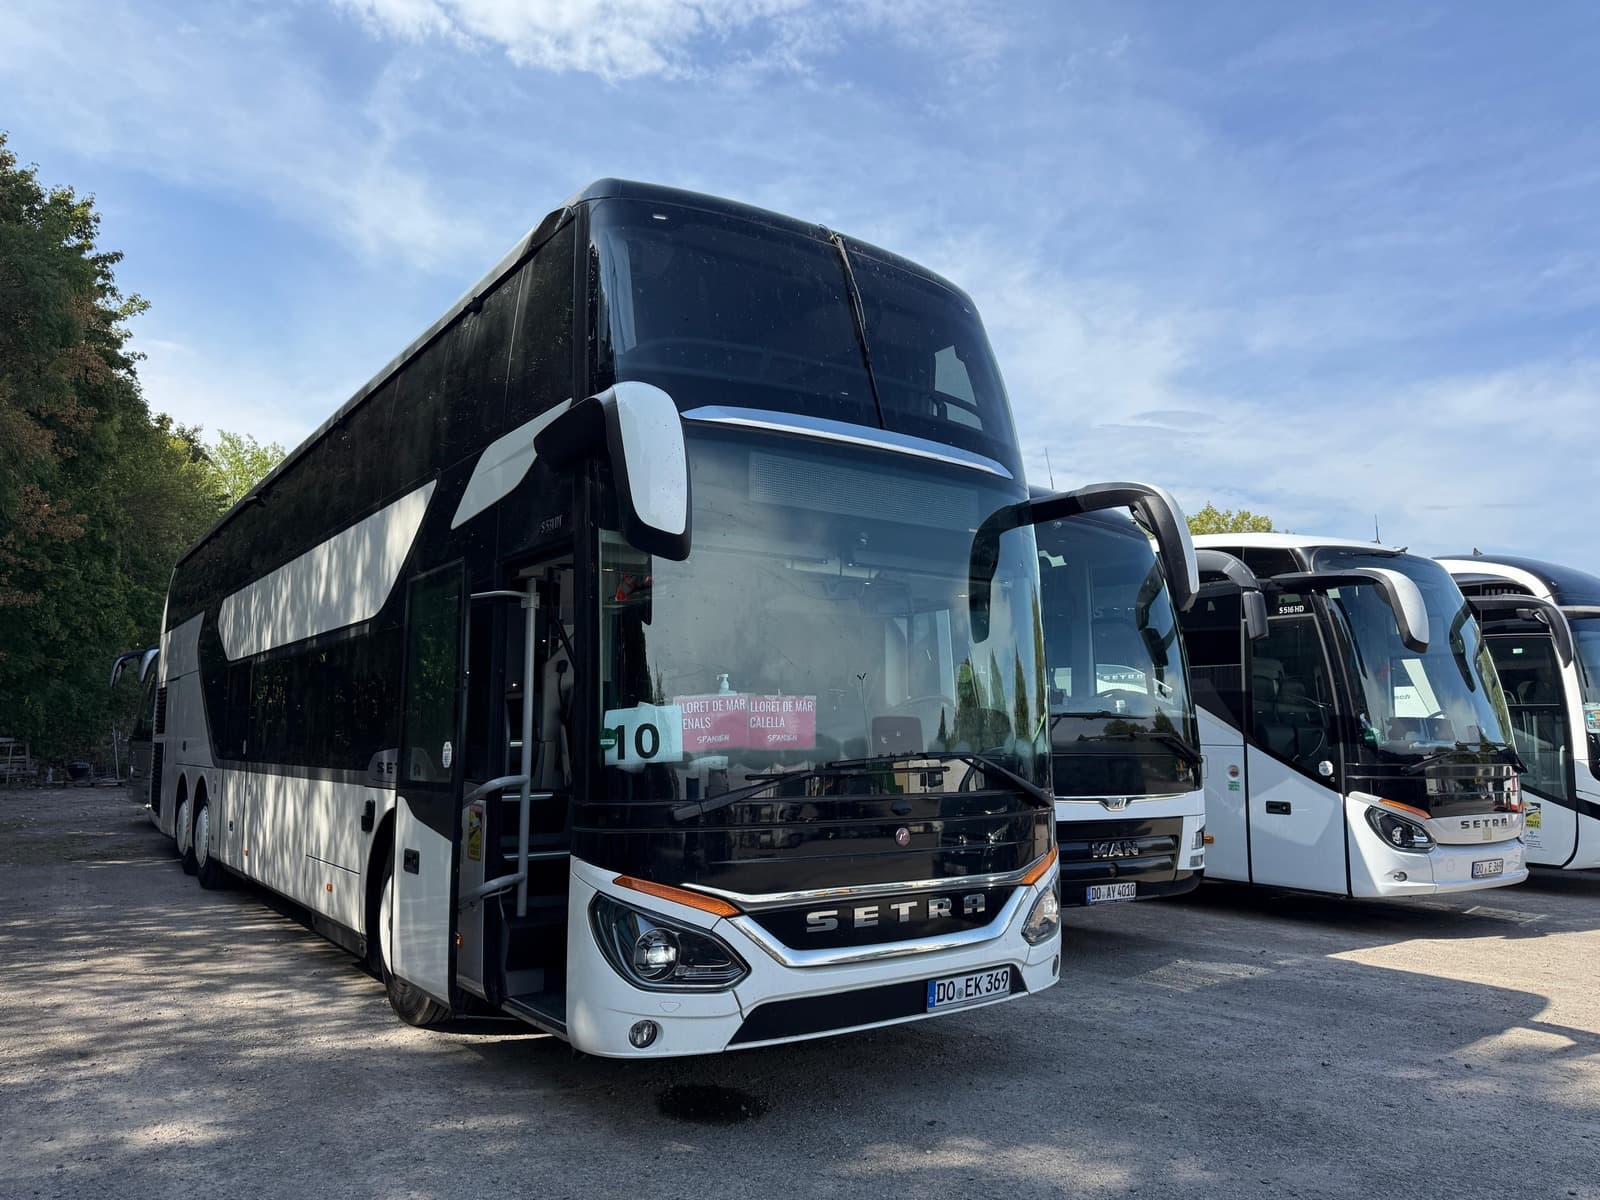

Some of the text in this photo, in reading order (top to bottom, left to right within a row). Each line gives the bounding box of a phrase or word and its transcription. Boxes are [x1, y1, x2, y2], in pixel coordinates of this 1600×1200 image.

[713, 700, 724, 712] DE
[726, 699, 746, 712] MAR
[750, 701, 814, 713] LLORET DE MAR
[750, 717, 786, 729] CALELLA
[614, 722, 661, 761] 10
[1460, 818, 1508, 829] SETRA
[1092, 840, 1139, 858] MAN
[1091, 887, 1101, 900] DO
[1106, 885, 1116, 898] AY
[806, 893, 986, 933] SETRA
[936, 981, 955, 1002] DO
[964, 976, 983, 996] EK
[985, 970, 1009, 992] 369
